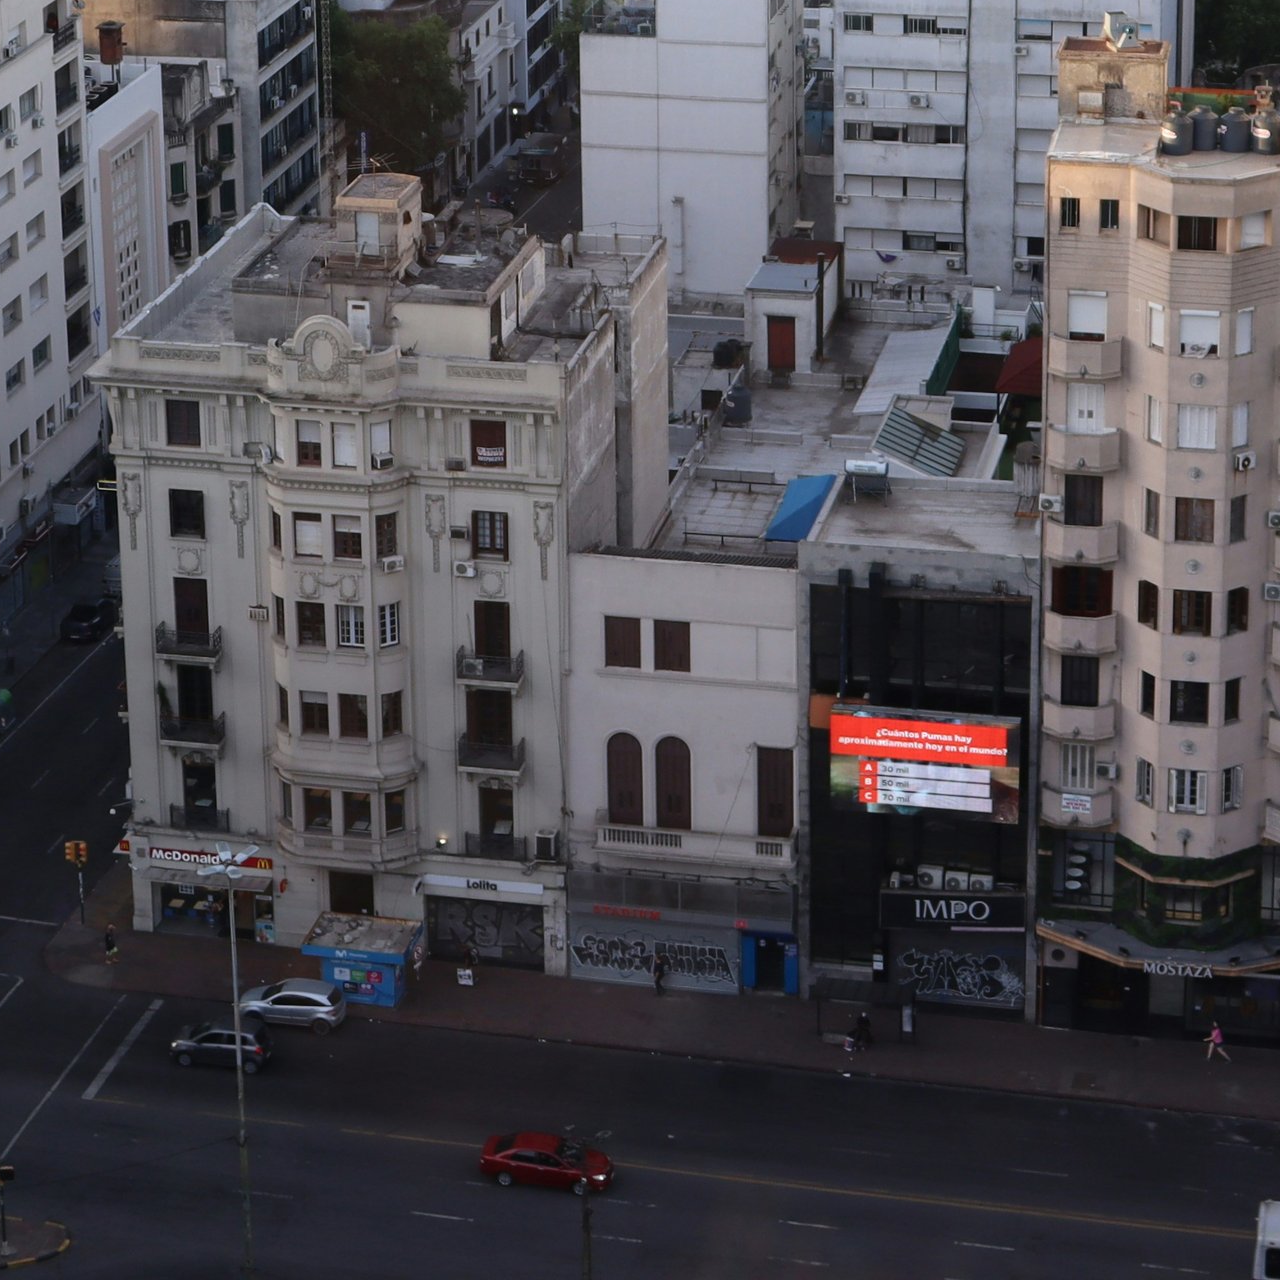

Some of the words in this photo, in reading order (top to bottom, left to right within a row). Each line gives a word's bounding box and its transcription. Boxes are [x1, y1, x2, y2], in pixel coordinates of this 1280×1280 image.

[876, 728, 920, 739] ¿Cuántos
[921, 731, 953, 741] Pumas
[954, 734, 972, 745] hay
[838, 736, 923, 750] aproximadamente
[926, 742, 944, 752] hoy
[970, 748, 1008, 756] mundo?
[864, 792, 872, 800] C
[152, 848, 221, 865] McDonald
[466, 879, 498, 891] Lolita
[914, 899, 990, 920] IMPO
[437, 898, 545, 952] RSK
[1143, 962, 1213, 979] MOSTAZA
